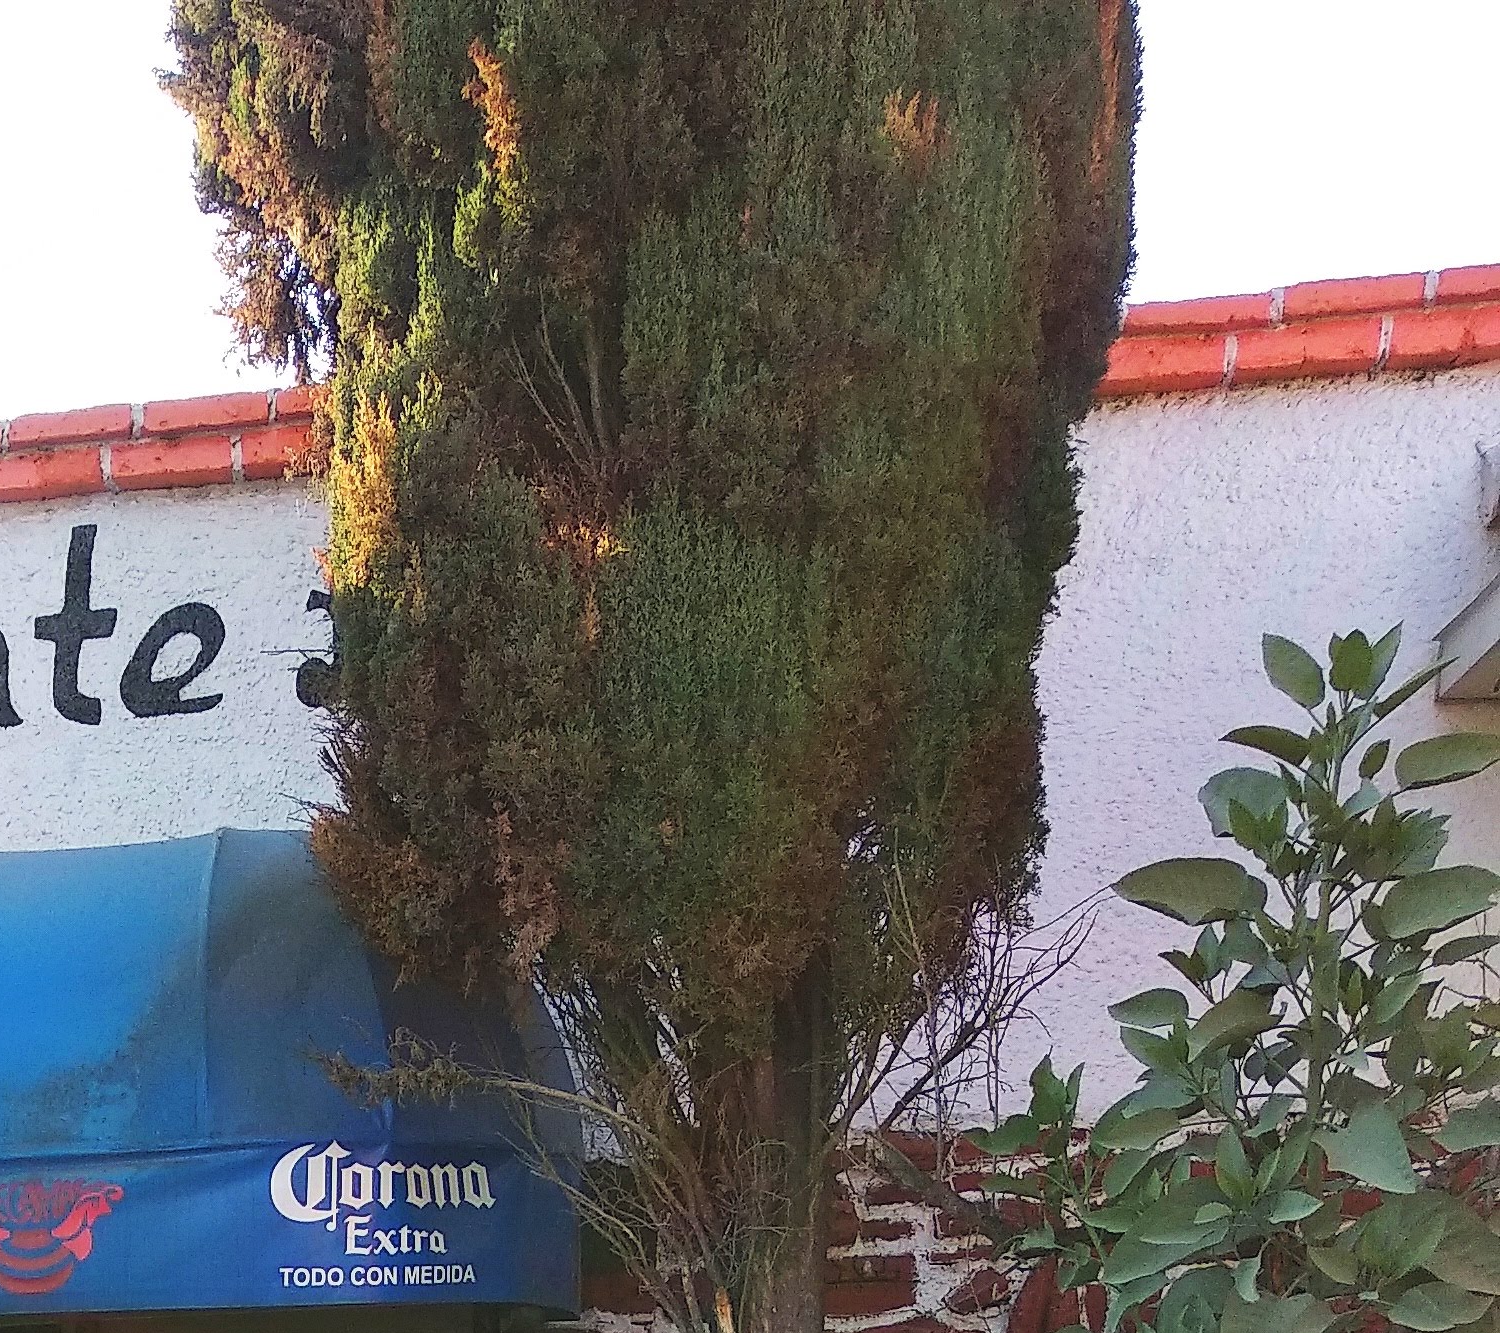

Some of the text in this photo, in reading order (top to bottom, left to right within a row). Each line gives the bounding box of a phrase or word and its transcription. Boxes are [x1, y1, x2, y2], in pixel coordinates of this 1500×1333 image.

[270, 1140, 497, 1232] Corona
[344, 1214, 449, 1256] Extra
[279, 1264, 476, 1287] TODO CON MEDIDA
